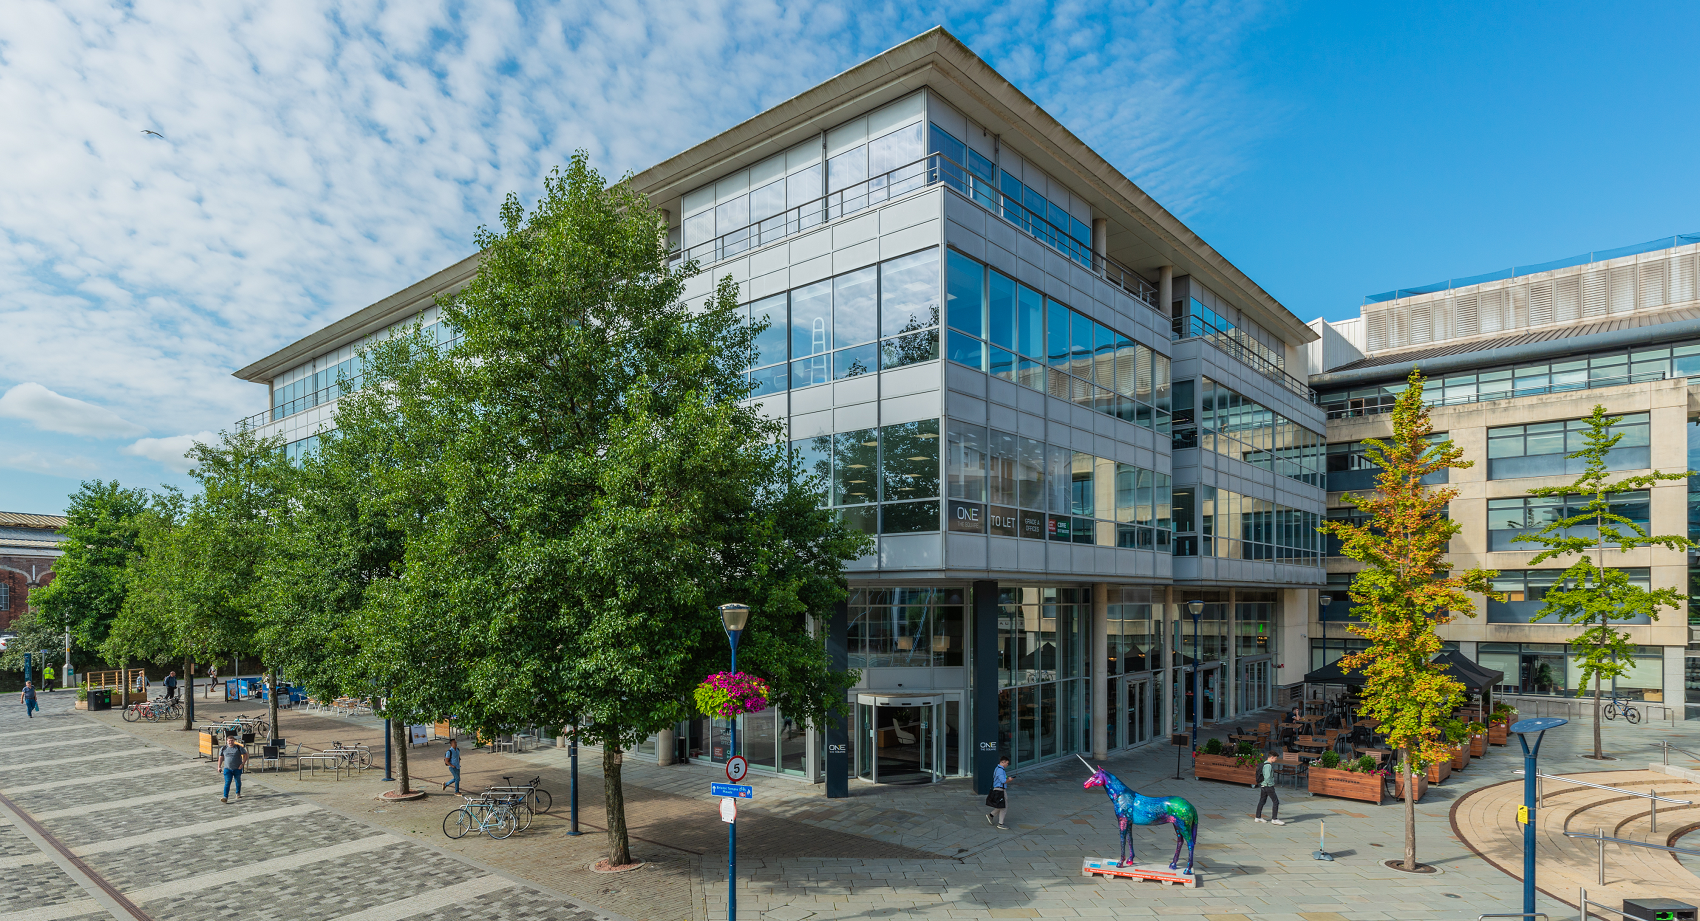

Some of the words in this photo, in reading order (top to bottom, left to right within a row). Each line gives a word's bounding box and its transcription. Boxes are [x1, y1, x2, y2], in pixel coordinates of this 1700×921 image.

[956, 506, 979, 521] ONE
[957, 520, 965, 528] THE
[990, 515, 1001, 527] TO
[1002, 516, 1015, 528] LET
[733, 763, 740, 774] 5
